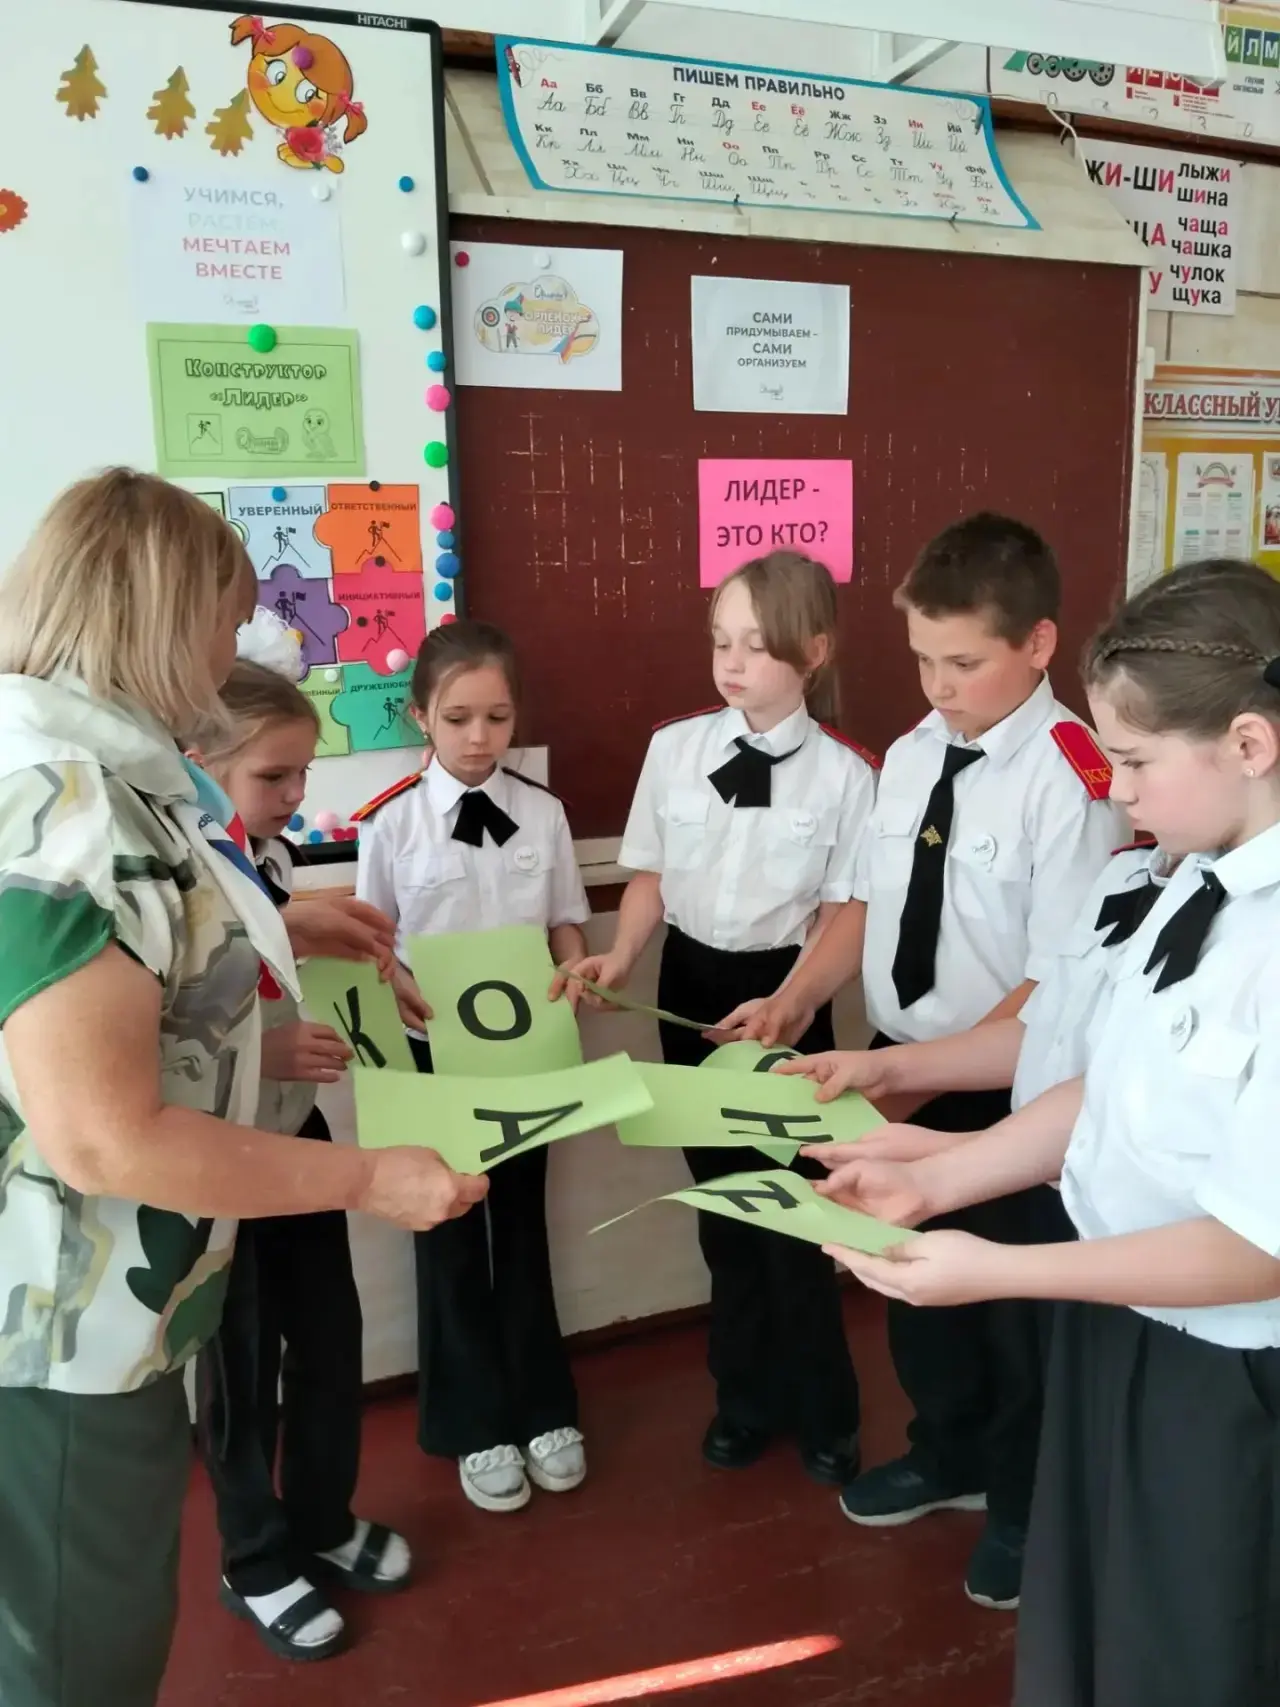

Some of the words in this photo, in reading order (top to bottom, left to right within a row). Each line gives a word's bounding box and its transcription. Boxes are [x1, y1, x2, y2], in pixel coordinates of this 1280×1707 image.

[357, 14, 407, 29] HITACHI
[1227, 30, 1239, 54] Й
[1246, 38, 1259, 57] Л
[1265, 40, 1279, 60] М
[673, 67, 738, 88] ПИШЕМ
[745, 76, 845, 101] ПРАВИЛЬНО
[541, 78, 558, 89] Аа
[585, 83, 603, 94] Бб
[630, 88, 647, 99] Вв
[712, 97, 731, 109] Дд
[752, 101, 766, 111] Ее
[829, 110, 852, 120] Жж
[1178, 162, 1231, 183] лыжи
[183, 186, 284, 209] УЧИМСЯ,
[1177, 187, 1228, 207] шина
[1178, 217, 1228, 238] чаща
[182, 237, 291, 256] МЕЧТАЕМ
[1171, 239, 1232, 259] чашка
[195, 262, 283, 280] ВМЕСТЕ
[1170, 264, 1225, 284] чулок
[1173, 287, 1222, 306] щука
[753, 312, 793, 324] САМИ
[726, 326, 811, 338] ПРИДУМЫВАЕМ
[752, 343, 793, 355] САМИ
[737, 358, 806, 368] ОРГАНИЗУЕМ
[1143, 391, 1260, 418] КЛАССНЫЙ
[724, 478, 806, 506] ЛИДЕР
[238, 504, 323, 517] УВЕРЕННЫЙ
[331, 502, 417, 511] ОТВЕТСТВЕННЫЙ
[716, 525, 763, 547] ЭТО
[771, 521, 828, 545] КТО?
[350, 680, 412, 694] ДРУЖЕЛЮБН
[457, 980, 532, 1041] О
[333, 986, 387, 1069] К
[473, 1100, 583, 1164] А
